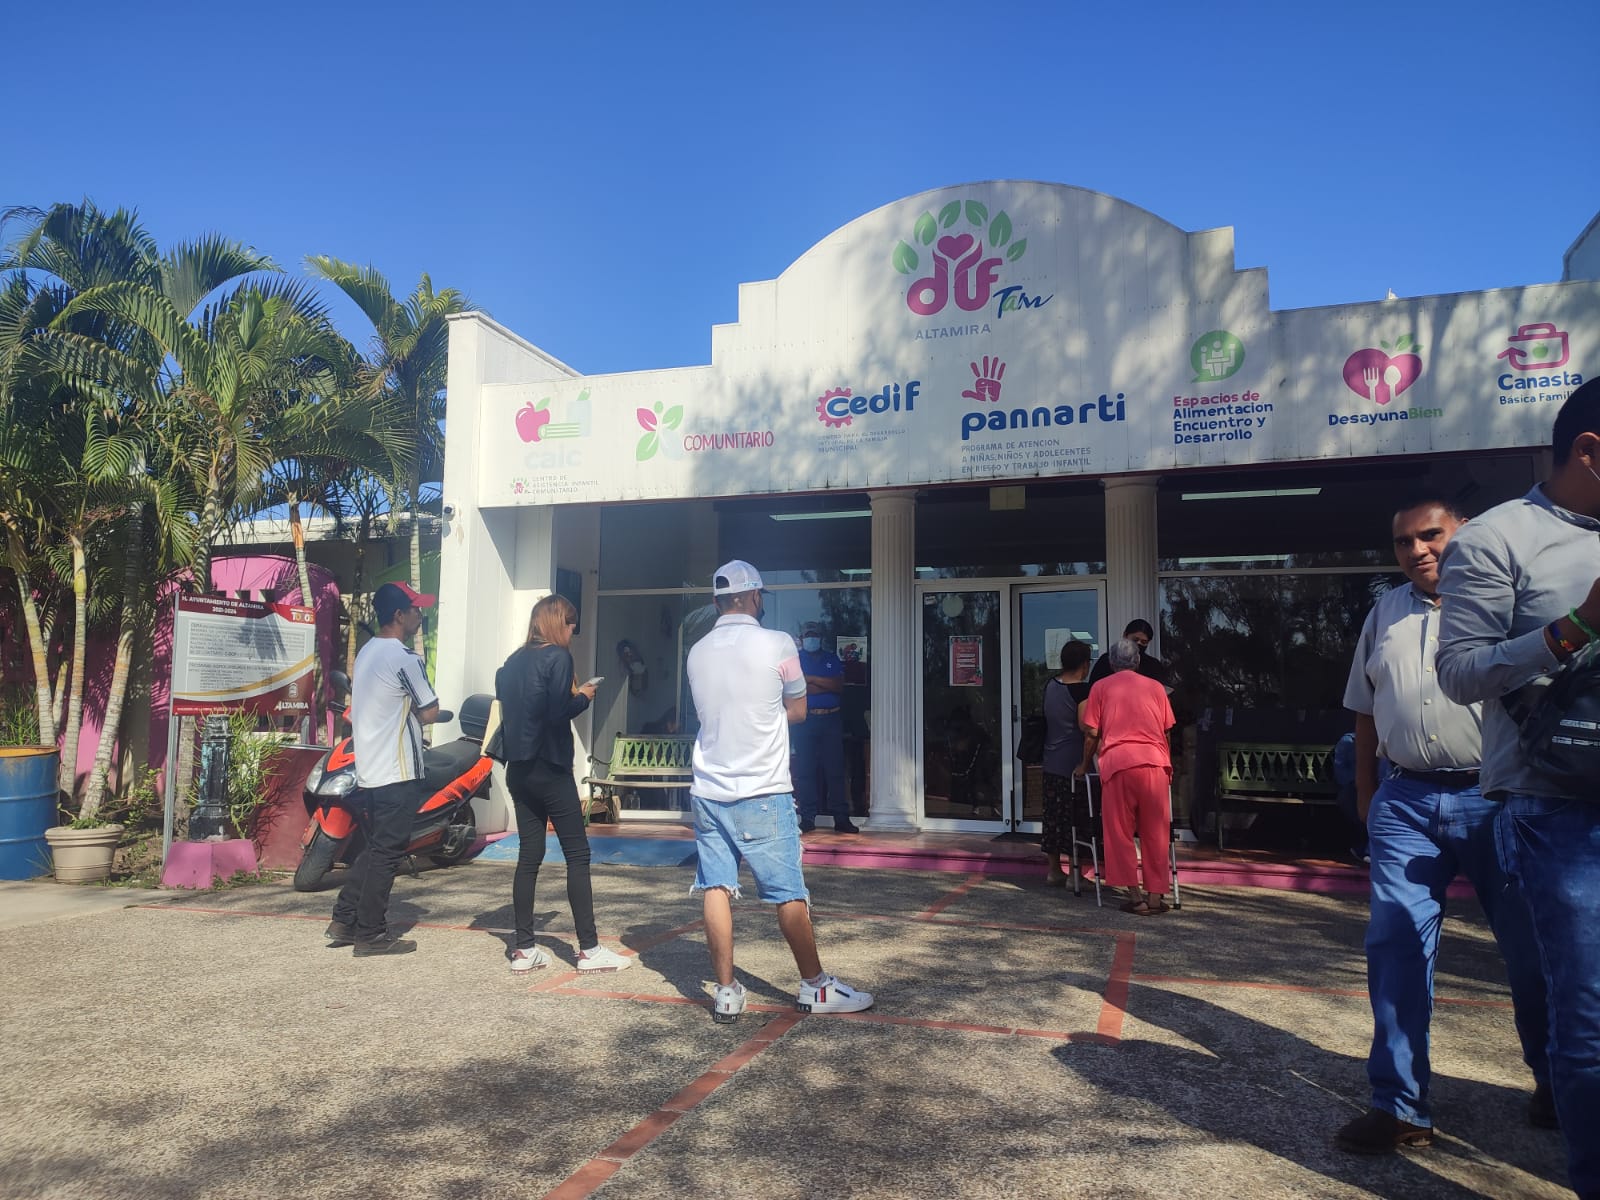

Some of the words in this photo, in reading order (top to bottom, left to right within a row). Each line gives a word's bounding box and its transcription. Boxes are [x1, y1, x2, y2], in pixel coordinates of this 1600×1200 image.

[992, 285, 1054, 319] Tam
[915, 323, 991, 340] ALTAMIRA
[1497, 370, 1583, 391] Canasta
[826, 380, 921, 418] cedif
[1173, 393, 1239, 408] Espacios
[1242, 390, 1260, 402] de
[961, 392, 1125, 440] pannarti
[1173, 402, 1273, 420] Alimentacion
[1174, 416, 1253, 432] Encuentro
[1256, 416, 1266, 428] y
[683, 430, 774, 451] COMUNITARIO
[1174, 429, 1253, 444] Desarrollo
[961, 442, 1003, 453] PROGRAMA
[1006, 441, 1015, 450] DE
[1019, 439, 1060, 449] ATENCION
[1024, 451, 1031, 459] Y
[1033, 447, 1091, 458] ADOLECENTES
[962, 465, 972, 474] EN
[1002, 463, 1009, 471] Y
[1012, 460, 1049, 470] TRABAJO
[1053, 458, 1091, 467] INFANTIL
